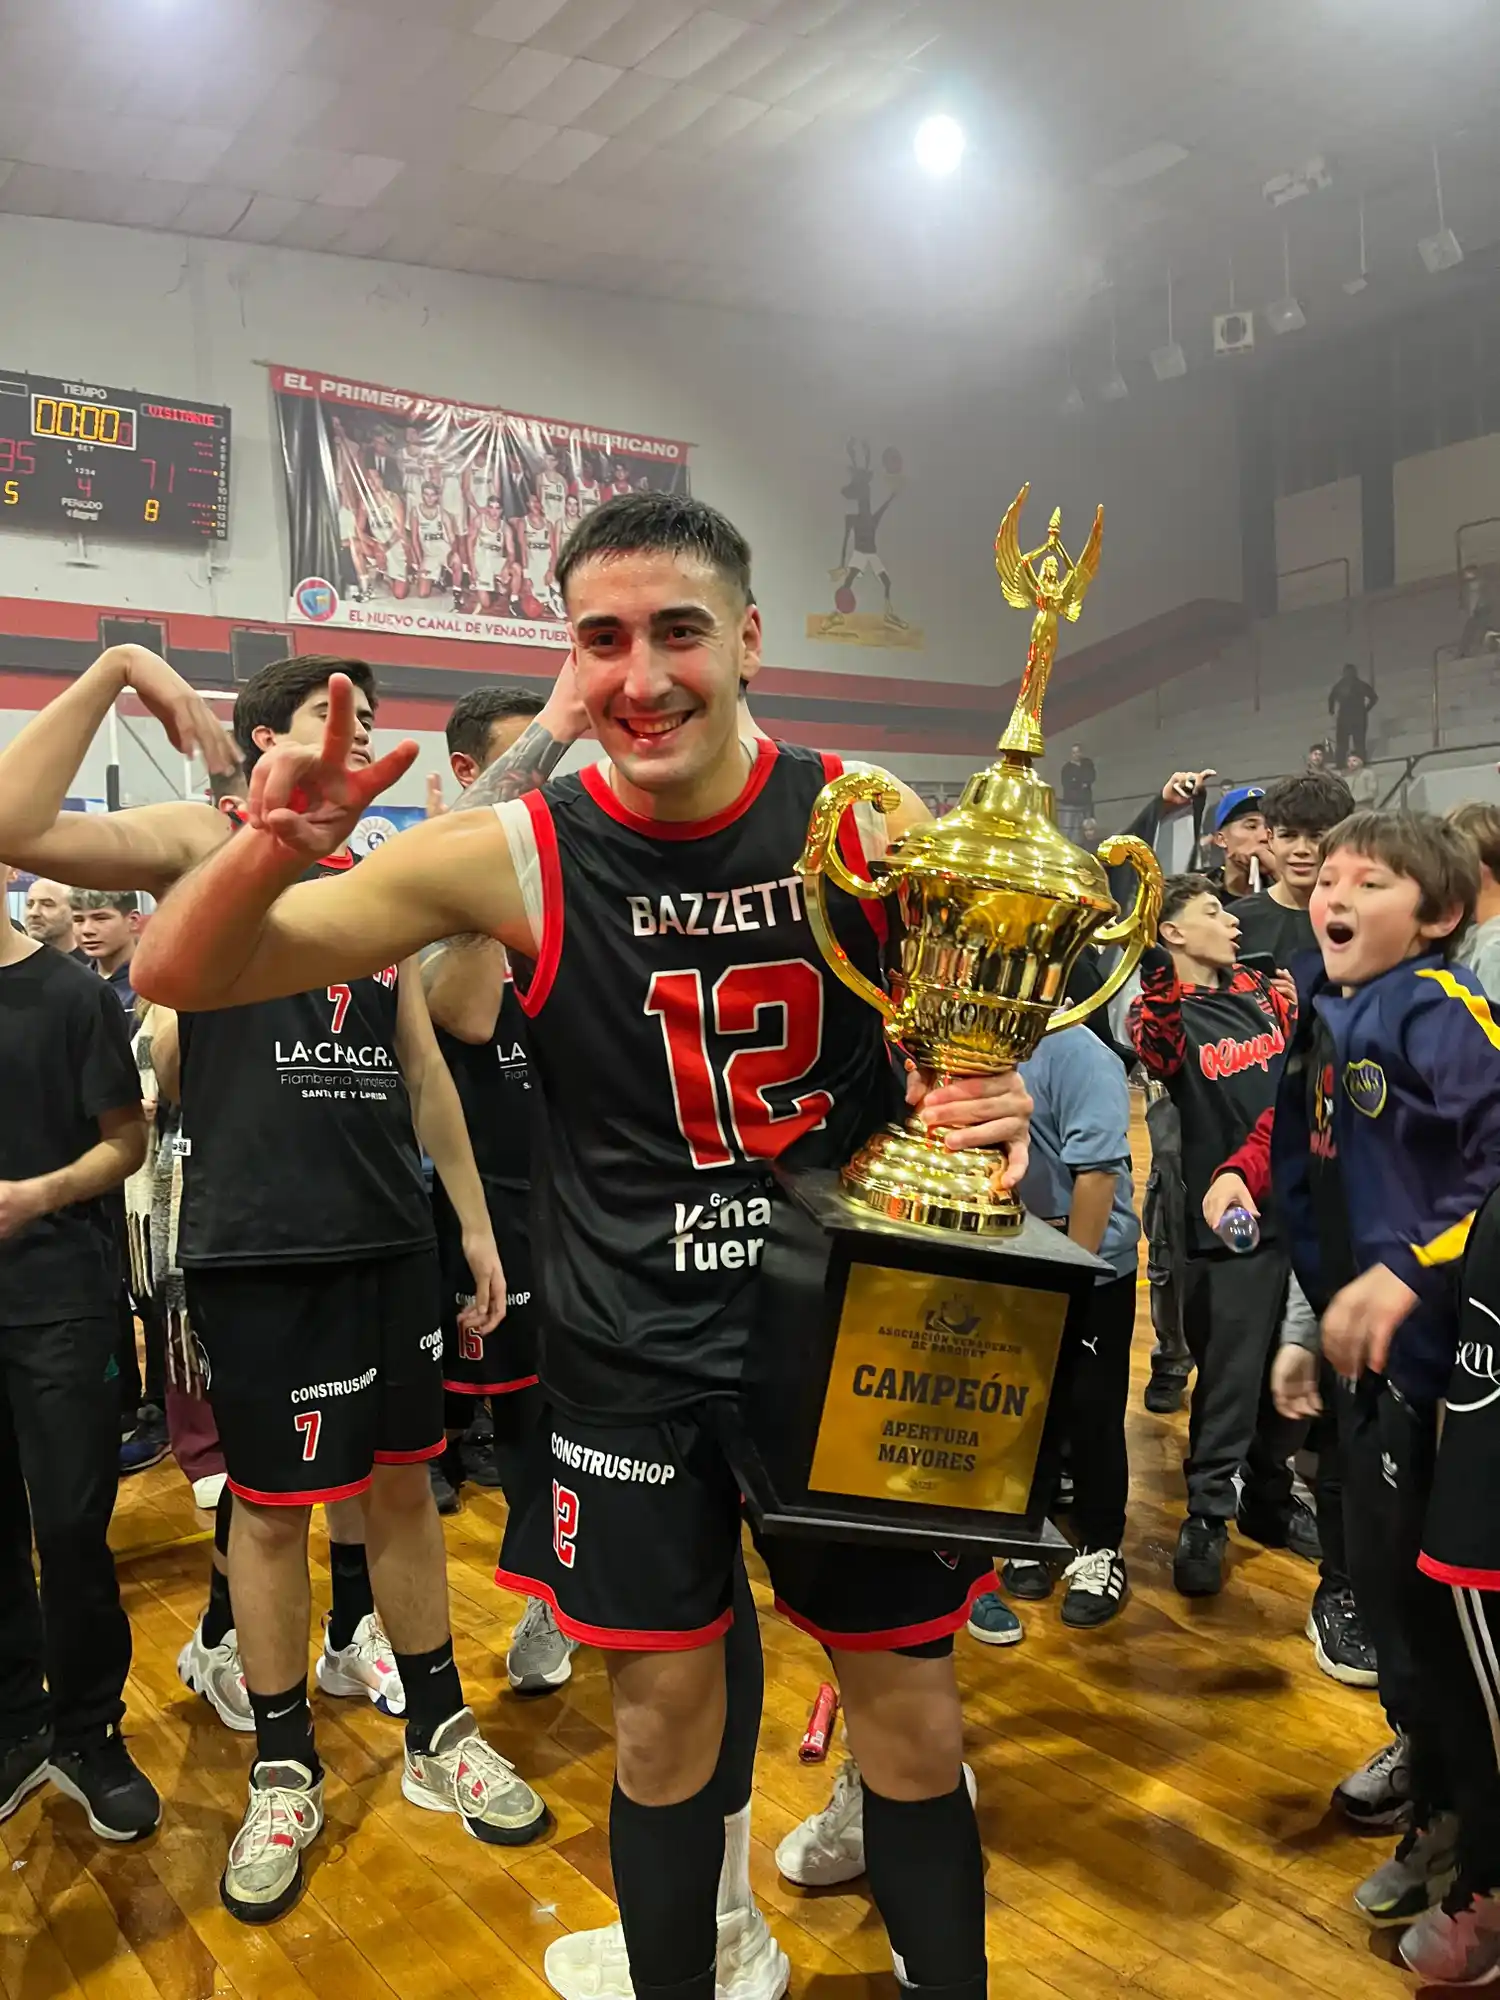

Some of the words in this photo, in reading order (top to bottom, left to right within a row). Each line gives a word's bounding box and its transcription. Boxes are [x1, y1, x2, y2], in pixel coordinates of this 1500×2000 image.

[61, 383, 108, 400] TIEMPO
[284, 372, 313, 391] EL
[320, 379, 410, 410] PRIMER
[144, 499, 160, 522] 8
[350, 610, 364, 622] EL
[367, 612, 413, 627] NUEVO
[417, 616, 461, 632] CANAL
[465, 621, 481, 633] DE
[485, 623, 536, 639] VENADO
[327, 983, 352, 1034] 7
[314, 1041, 393, 1067] CHACR
[497, 1042, 526, 1062] LA
[643, 957, 835, 1170] 12
[334, 1090, 347, 1099] FE
[350, 1090, 357, 1099] Y
[911, 1340, 927, 1351] DE
[291, 1368, 377, 1404] CONSTRUSHOP
[852, 1364, 1030, 1417] CAMPEÓN
[294, 1410, 322, 1461] 7
[882, 1420, 980, 1447] APERTURA
[551, 1432, 676, 1486] CONSTRUSHOP
[878, 1443, 977, 1472] MAYORES
